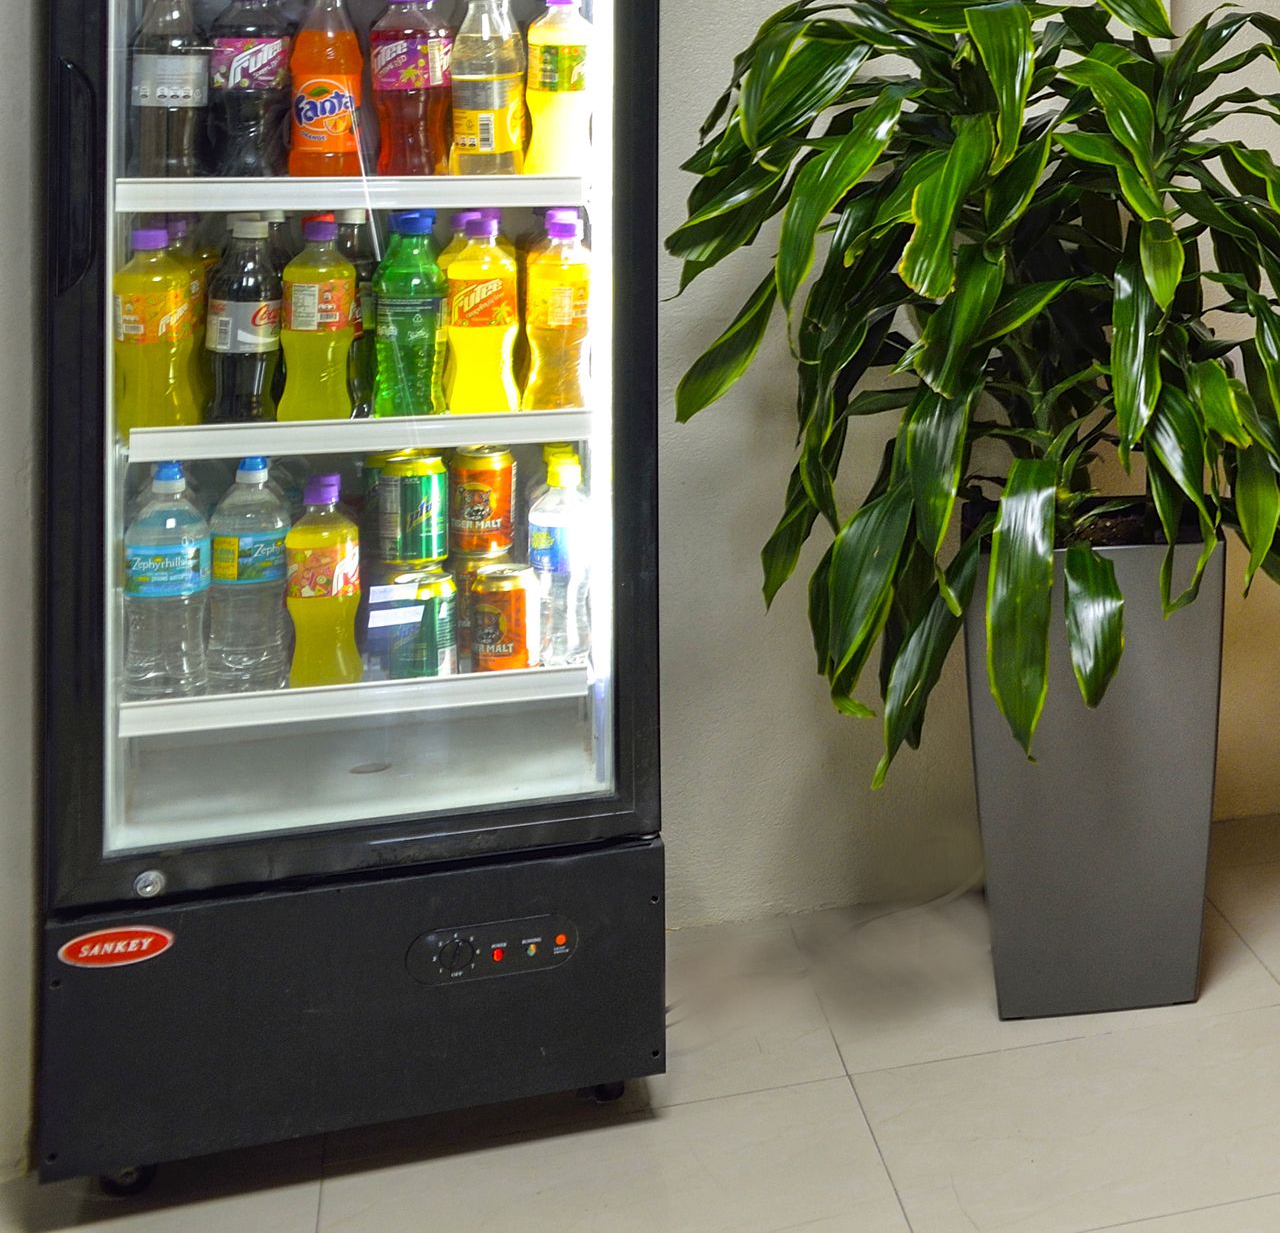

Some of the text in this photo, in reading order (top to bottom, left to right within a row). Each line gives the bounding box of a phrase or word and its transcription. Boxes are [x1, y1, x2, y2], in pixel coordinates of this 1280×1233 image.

[474, 518, 502, 529] MALT
[486, 643, 514, 654] MALT
[78, 936, 155, 958] SANKEY
